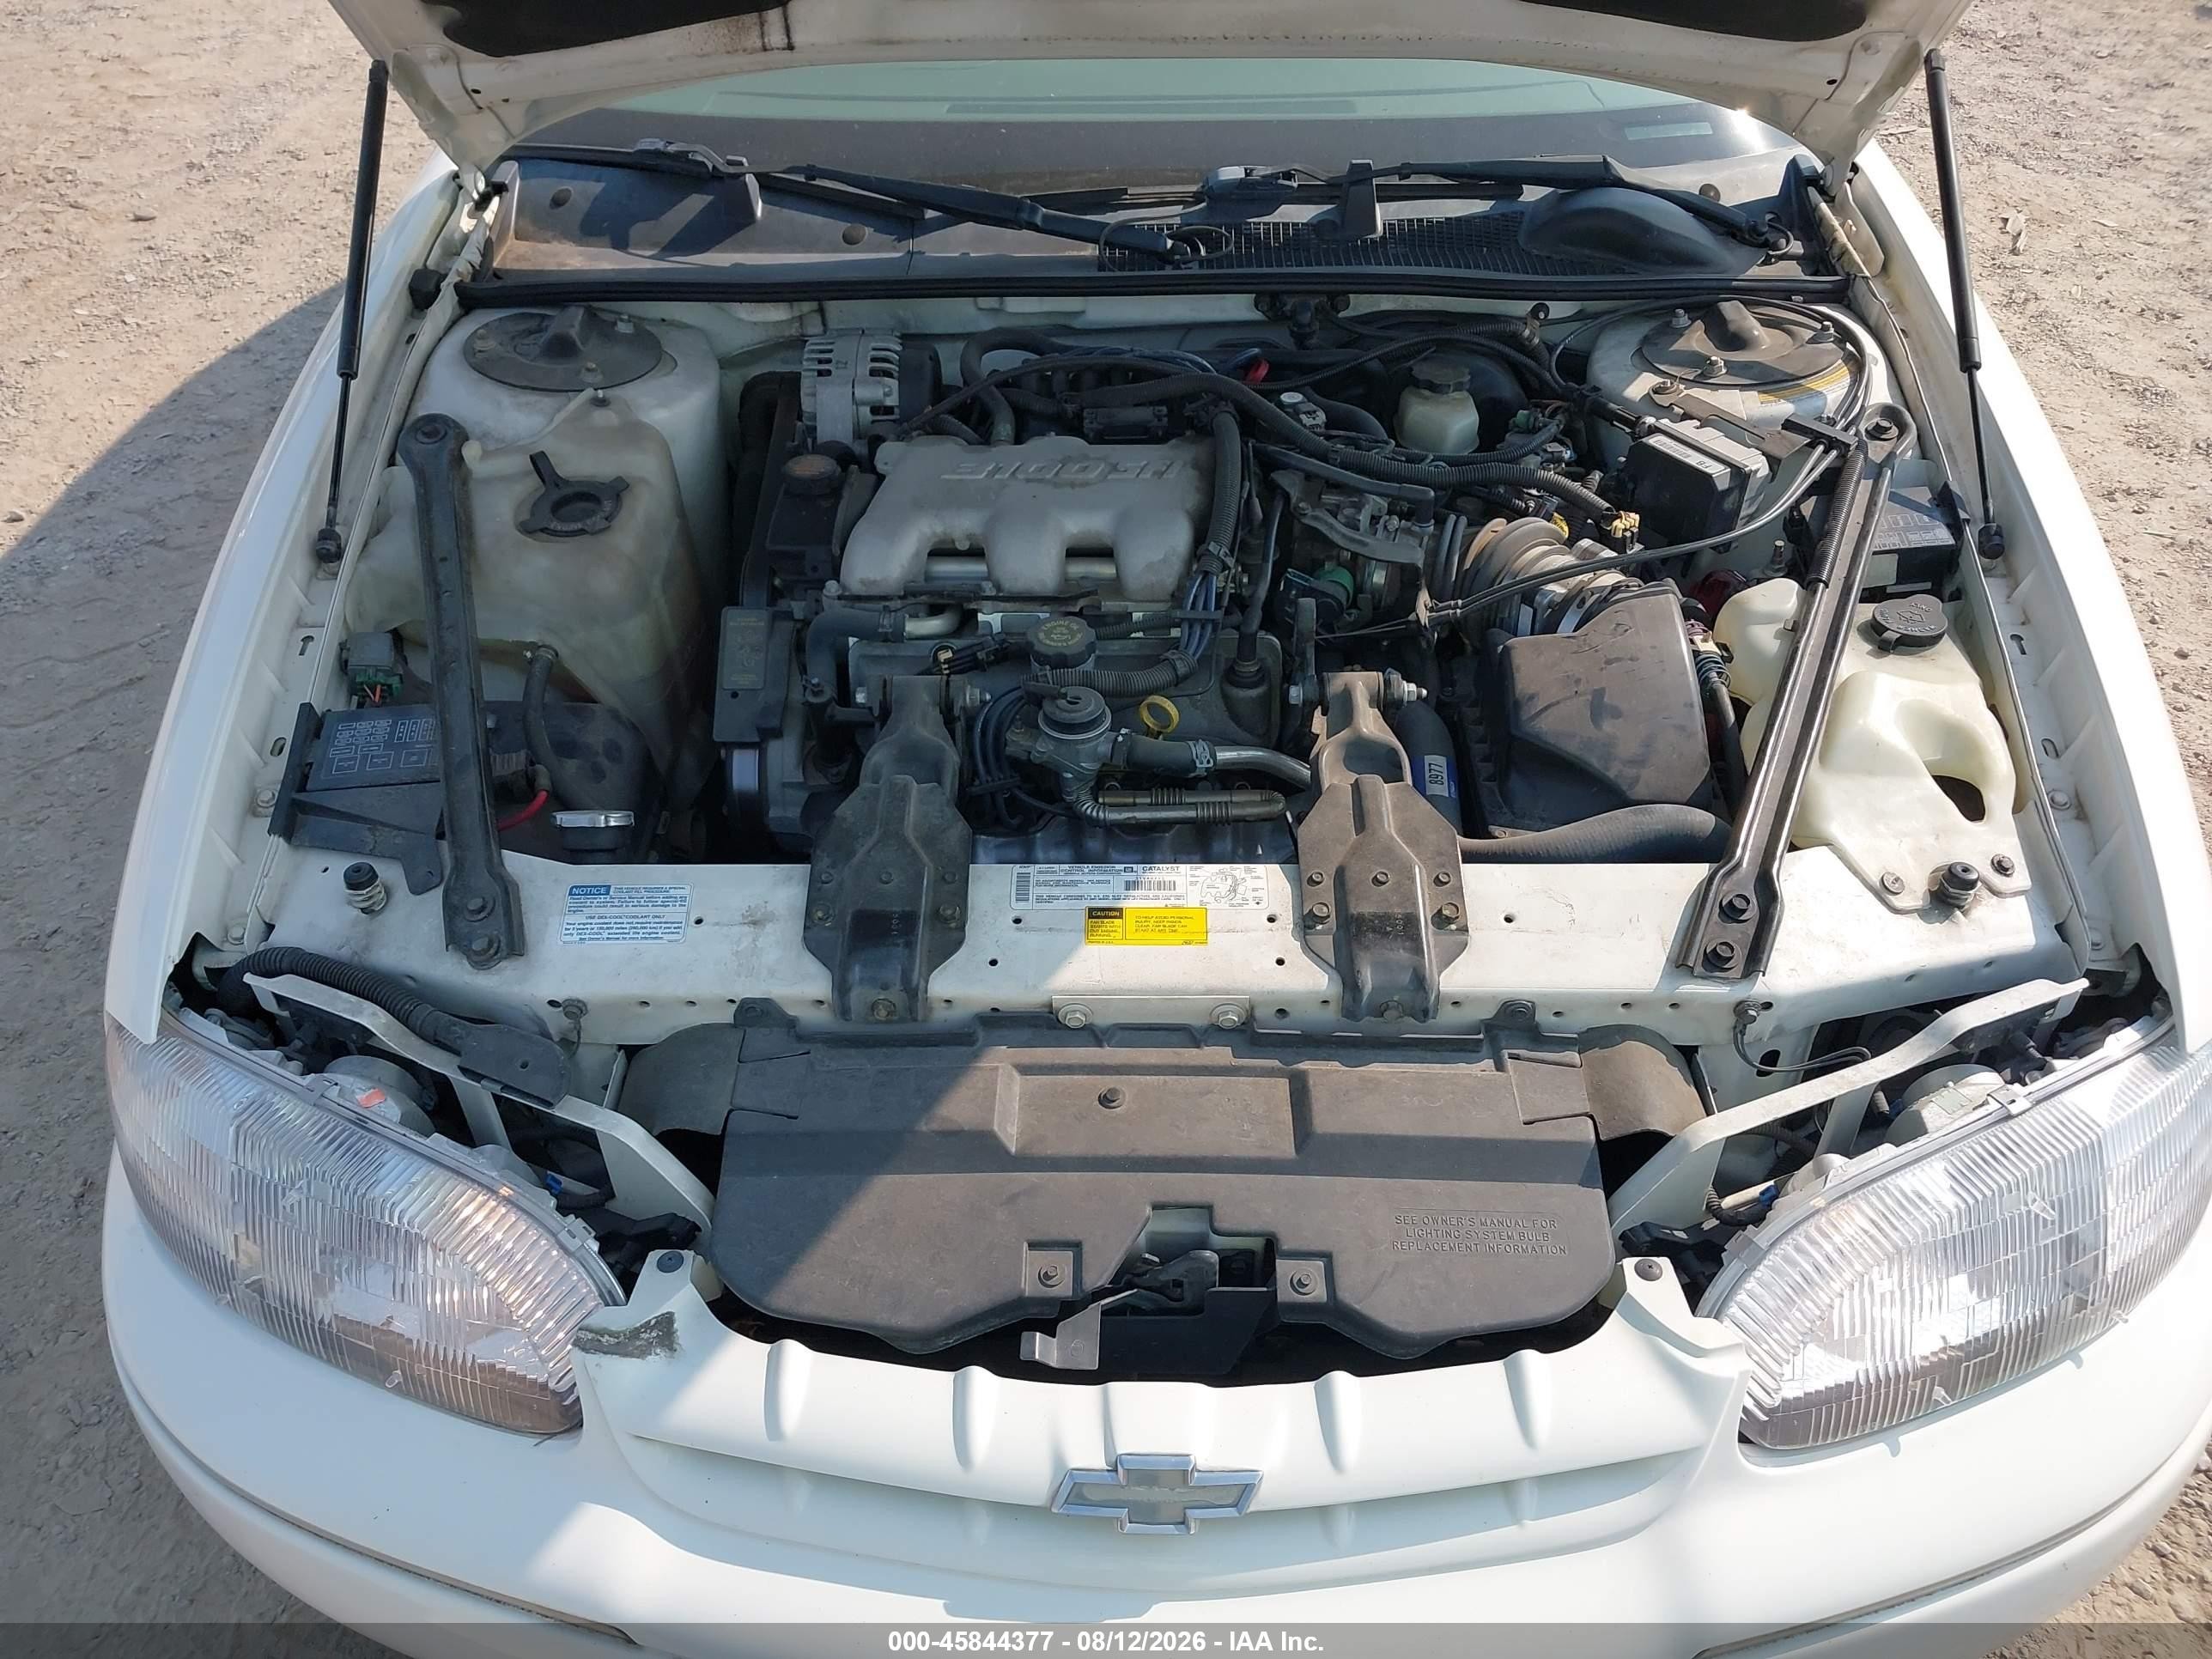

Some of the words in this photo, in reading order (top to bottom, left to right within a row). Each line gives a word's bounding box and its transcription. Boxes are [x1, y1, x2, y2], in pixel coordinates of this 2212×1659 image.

[1428, 763, 1444, 786] 8977
[1395, 1215, 1418, 1225] SEE
[1422, 1216, 1476, 1227] OWNER'S
[1480, 1218, 1528, 1229] MANUAL
[1532, 1219, 1557, 1230] FOR
[1406, 1228, 1462, 1239] LIGHTING
[1465, 1230, 1515, 1242] SYSTEM
[1518, 1231, 1550, 1242] BULB
[1392, 1241, 1480, 1253] REPLACEMENT
[1485, 1243, 1567, 1255] INFORMATION
